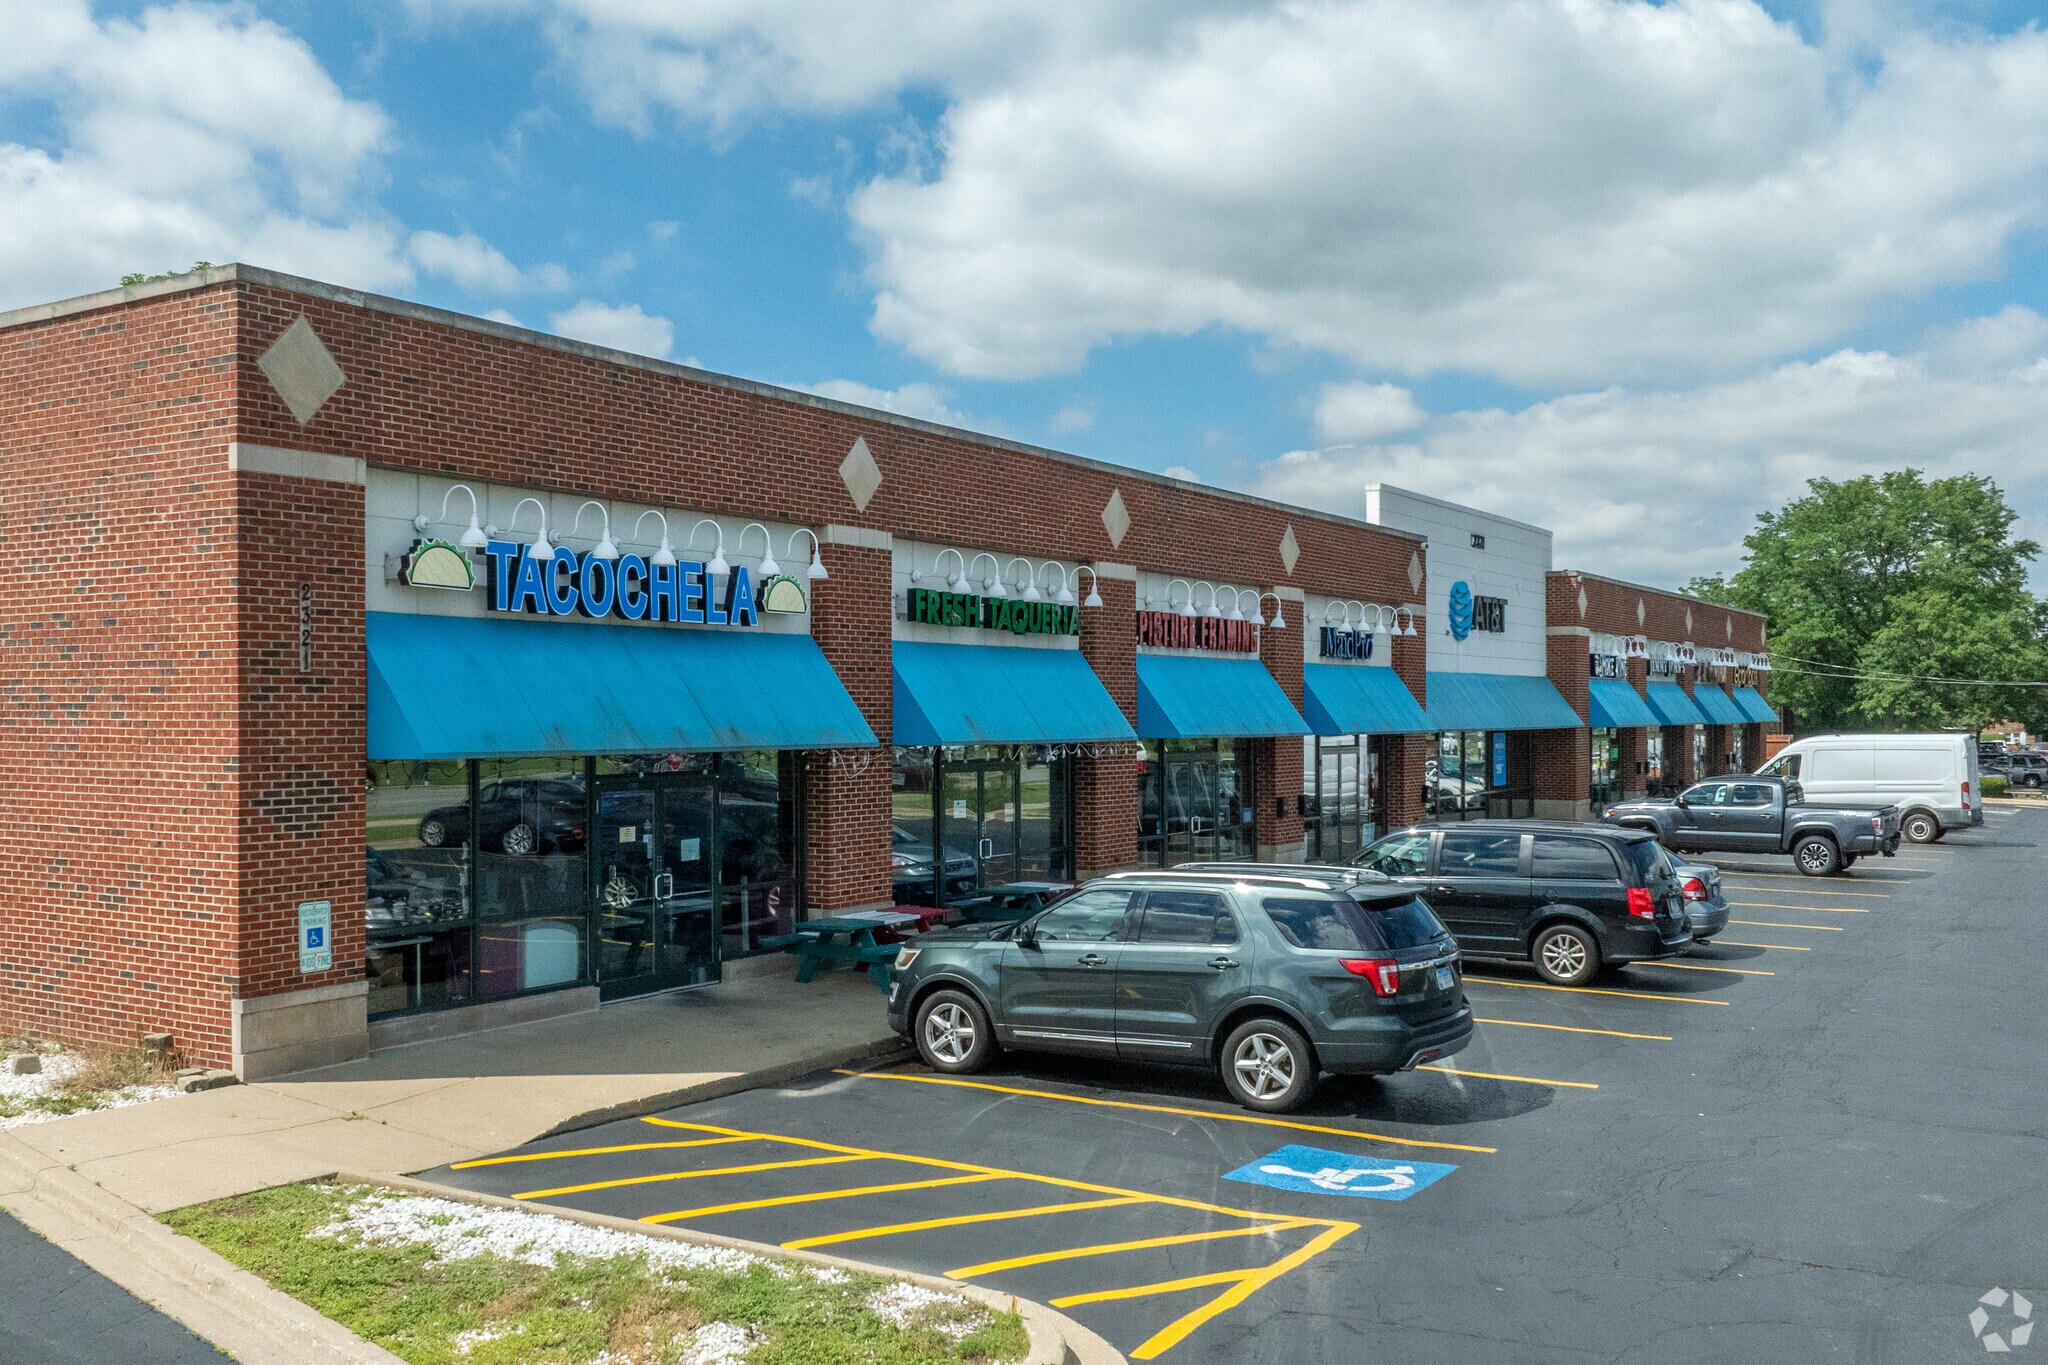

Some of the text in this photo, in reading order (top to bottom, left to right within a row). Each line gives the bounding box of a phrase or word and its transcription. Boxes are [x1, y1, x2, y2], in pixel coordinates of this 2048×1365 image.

[486, 540, 758, 627] TACOCHELA
[301, 583, 311, 670] 2321
[910, 588, 1081, 635] FRESH TAQUERIA
[1473, 595, 1508, 633] AT&T
[1138, 610, 1258, 653] PICTURE FRAMING
[1323, 626, 1373, 660] MaidPro
[301, 907, 328, 917] RESERVED
[303, 916, 327, 926] PARKING
[317, 954, 330, 966] FINE
